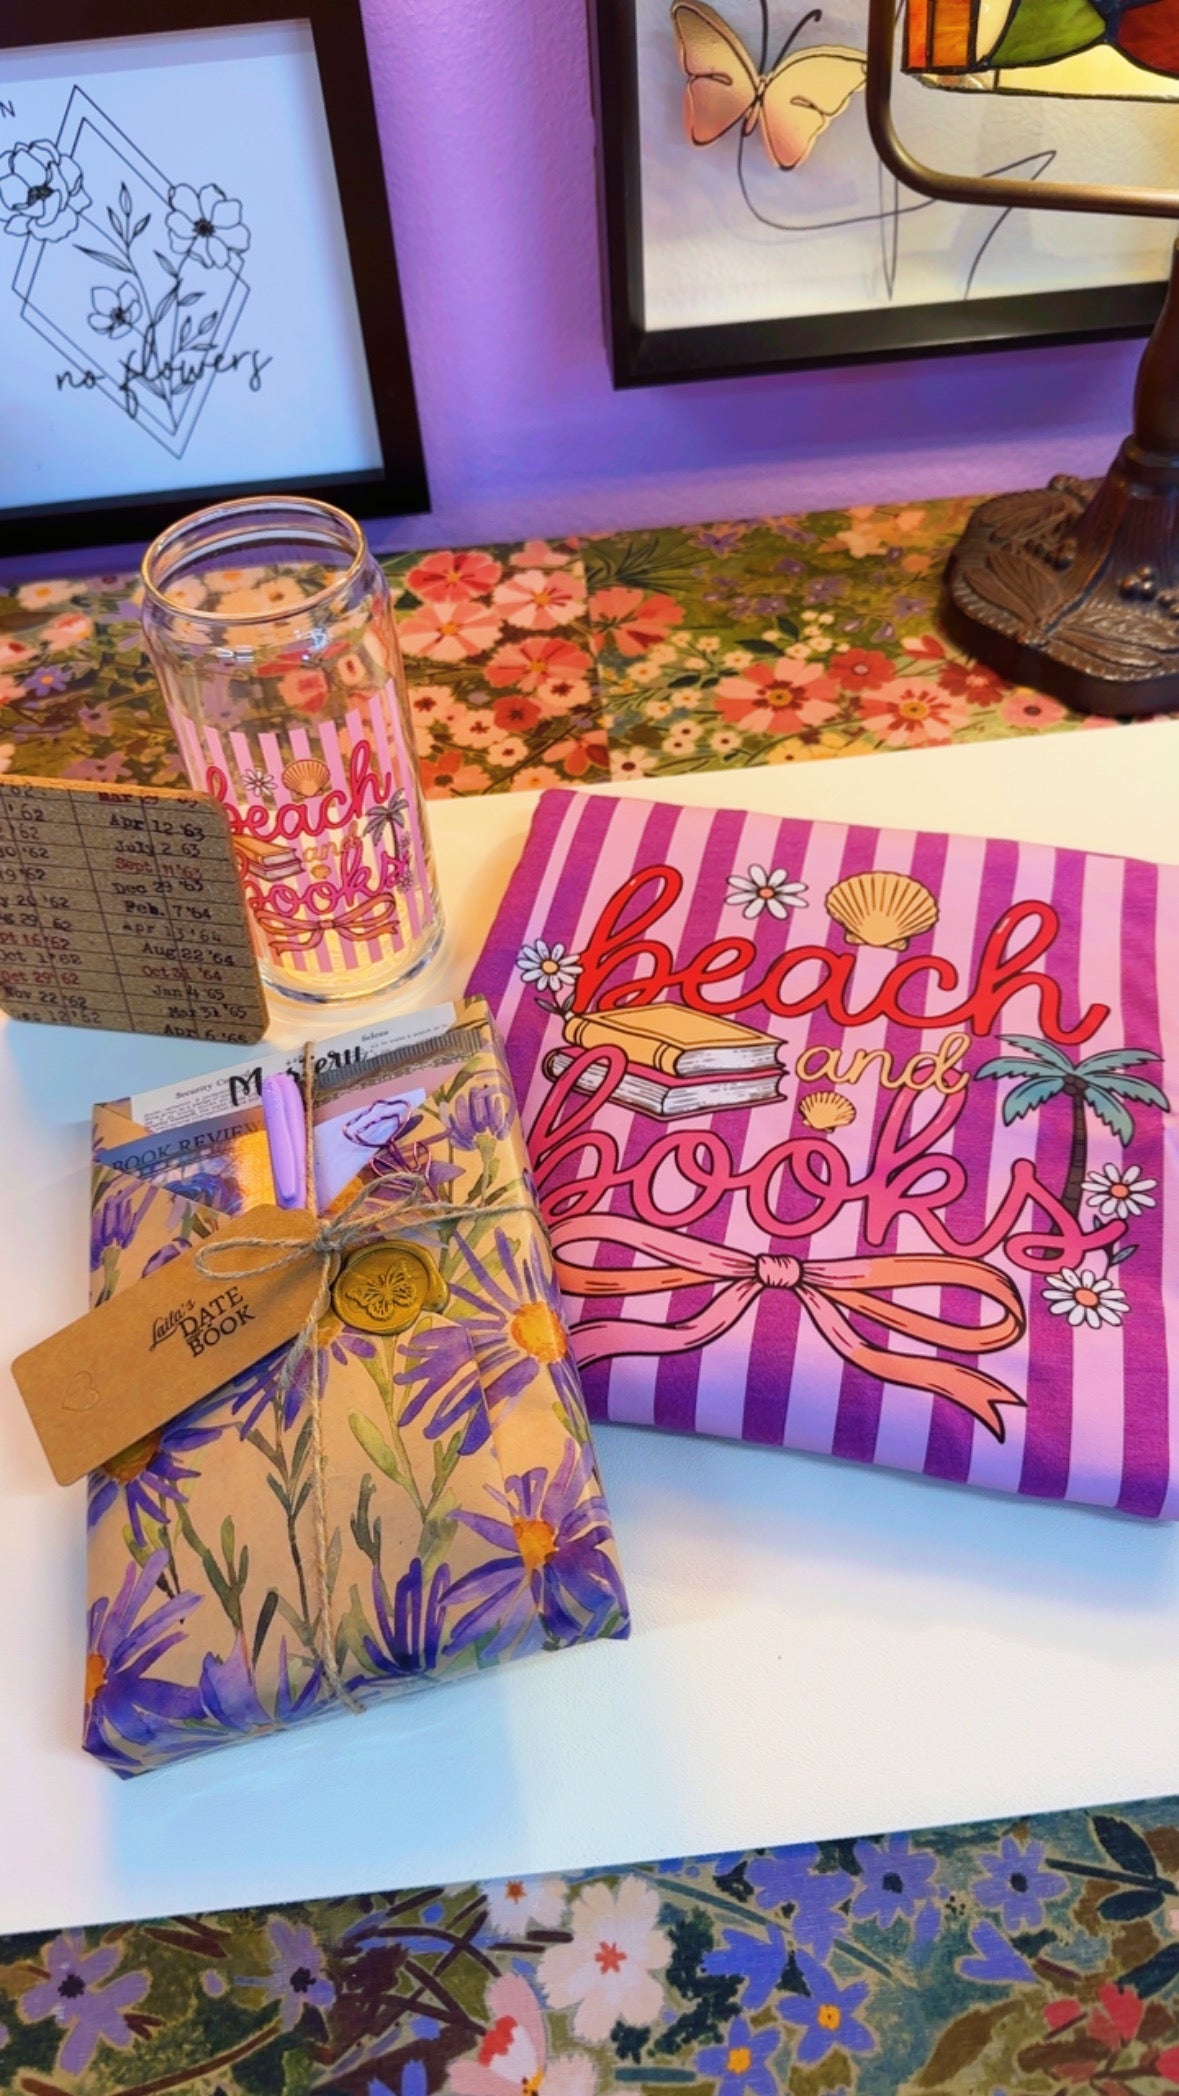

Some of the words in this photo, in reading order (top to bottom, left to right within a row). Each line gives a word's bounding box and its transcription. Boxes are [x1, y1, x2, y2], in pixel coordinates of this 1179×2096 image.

[56, 370, 105, 391] no
[118, 326, 273, 418] flowers
[115, 857, 153, 873] Sept
[141, 965, 171, 978] Oct
[142, 942, 177, 960] Aug
[181, 948, 204, 961] 22
[574, 864, 1110, 1044] beach
[151, 984, 182, 997] Jan
[796, 1032, 971, 1094] and
[111, 1144, 172, 1171] BOOK
[529, 1044, 1127, 1273] books
[179, 1286, 244, 1338] DATE
[186, 1305, 256, 1358] BOOK
